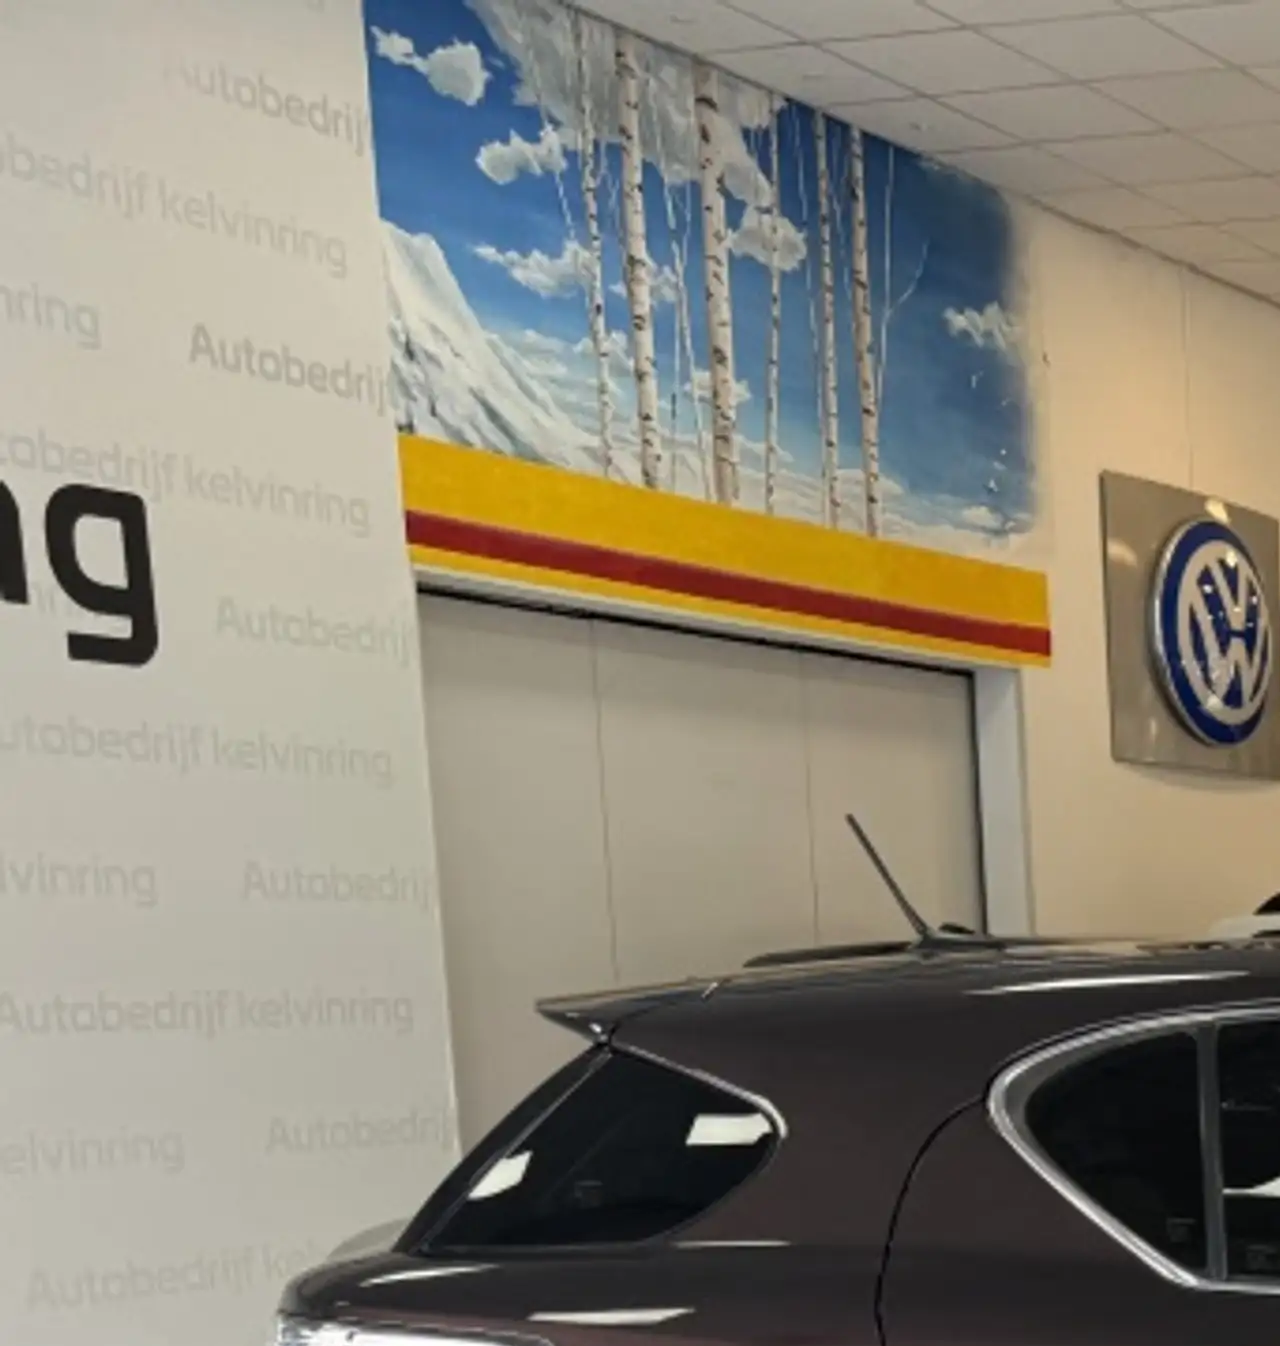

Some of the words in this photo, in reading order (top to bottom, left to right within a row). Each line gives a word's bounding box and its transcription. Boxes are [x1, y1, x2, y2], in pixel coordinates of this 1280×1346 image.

[162, 55, 368, 157] Autobedrij
[0, 130, 148, 220] bedrijf
[158, 178, 349, 280] kelvinring
[189, 322, 390, 418] Autobedrij
[186, 453, 370, 539] kelvinring
[215, 596, 414, 669] Autobedrij
[211, 727, 397, 791] kelvinring
[242, 860, 434, 913] Autobedrij
[0, 991, 230, 1040] Autobedrijf
[237, 986, 415, 1035] kelvinring
[264, 1107, 454, 1153] Autobedrij
[27, 1243, 254, 1314] Autobedrijf
